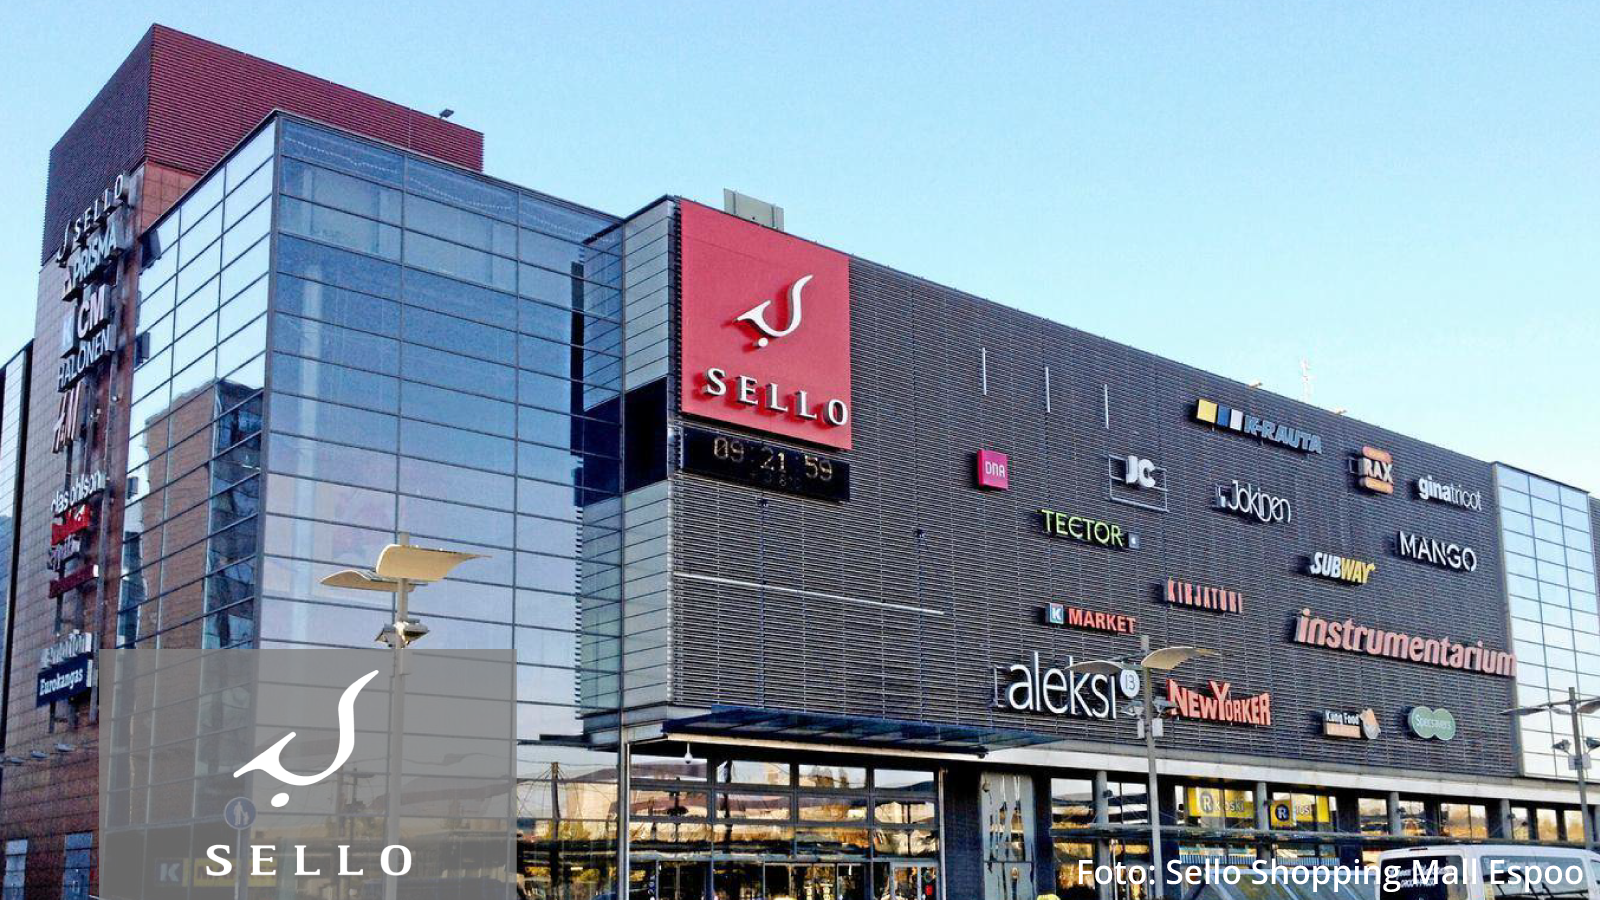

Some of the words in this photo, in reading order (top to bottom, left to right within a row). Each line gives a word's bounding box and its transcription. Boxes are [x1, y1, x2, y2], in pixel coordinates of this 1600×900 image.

[73, 173, 124, 242] SELLO
[72, 221, 117, 288] PRISMA
[77, 284, 105, 339] CM
[58, 325, 110, 391] HALONEN
[706, 368, 849, 427] SELLO
[1244, 415, 1322, 455] K-RAUTA
[1126, 455, 1156, 488] JC
[1360, 458, 1394, 484] RAX
[1041, 508, 1124, 548] TECTOR
[1310, 551, 1377, 584] SUBWAY
[1398, 531, 1478, 573] MANGO
[1051, 606, 1062, 621] K
[1068, 607, 1136, 635] MARKET
[1298, 608, 1517, 677] instrumentarium
